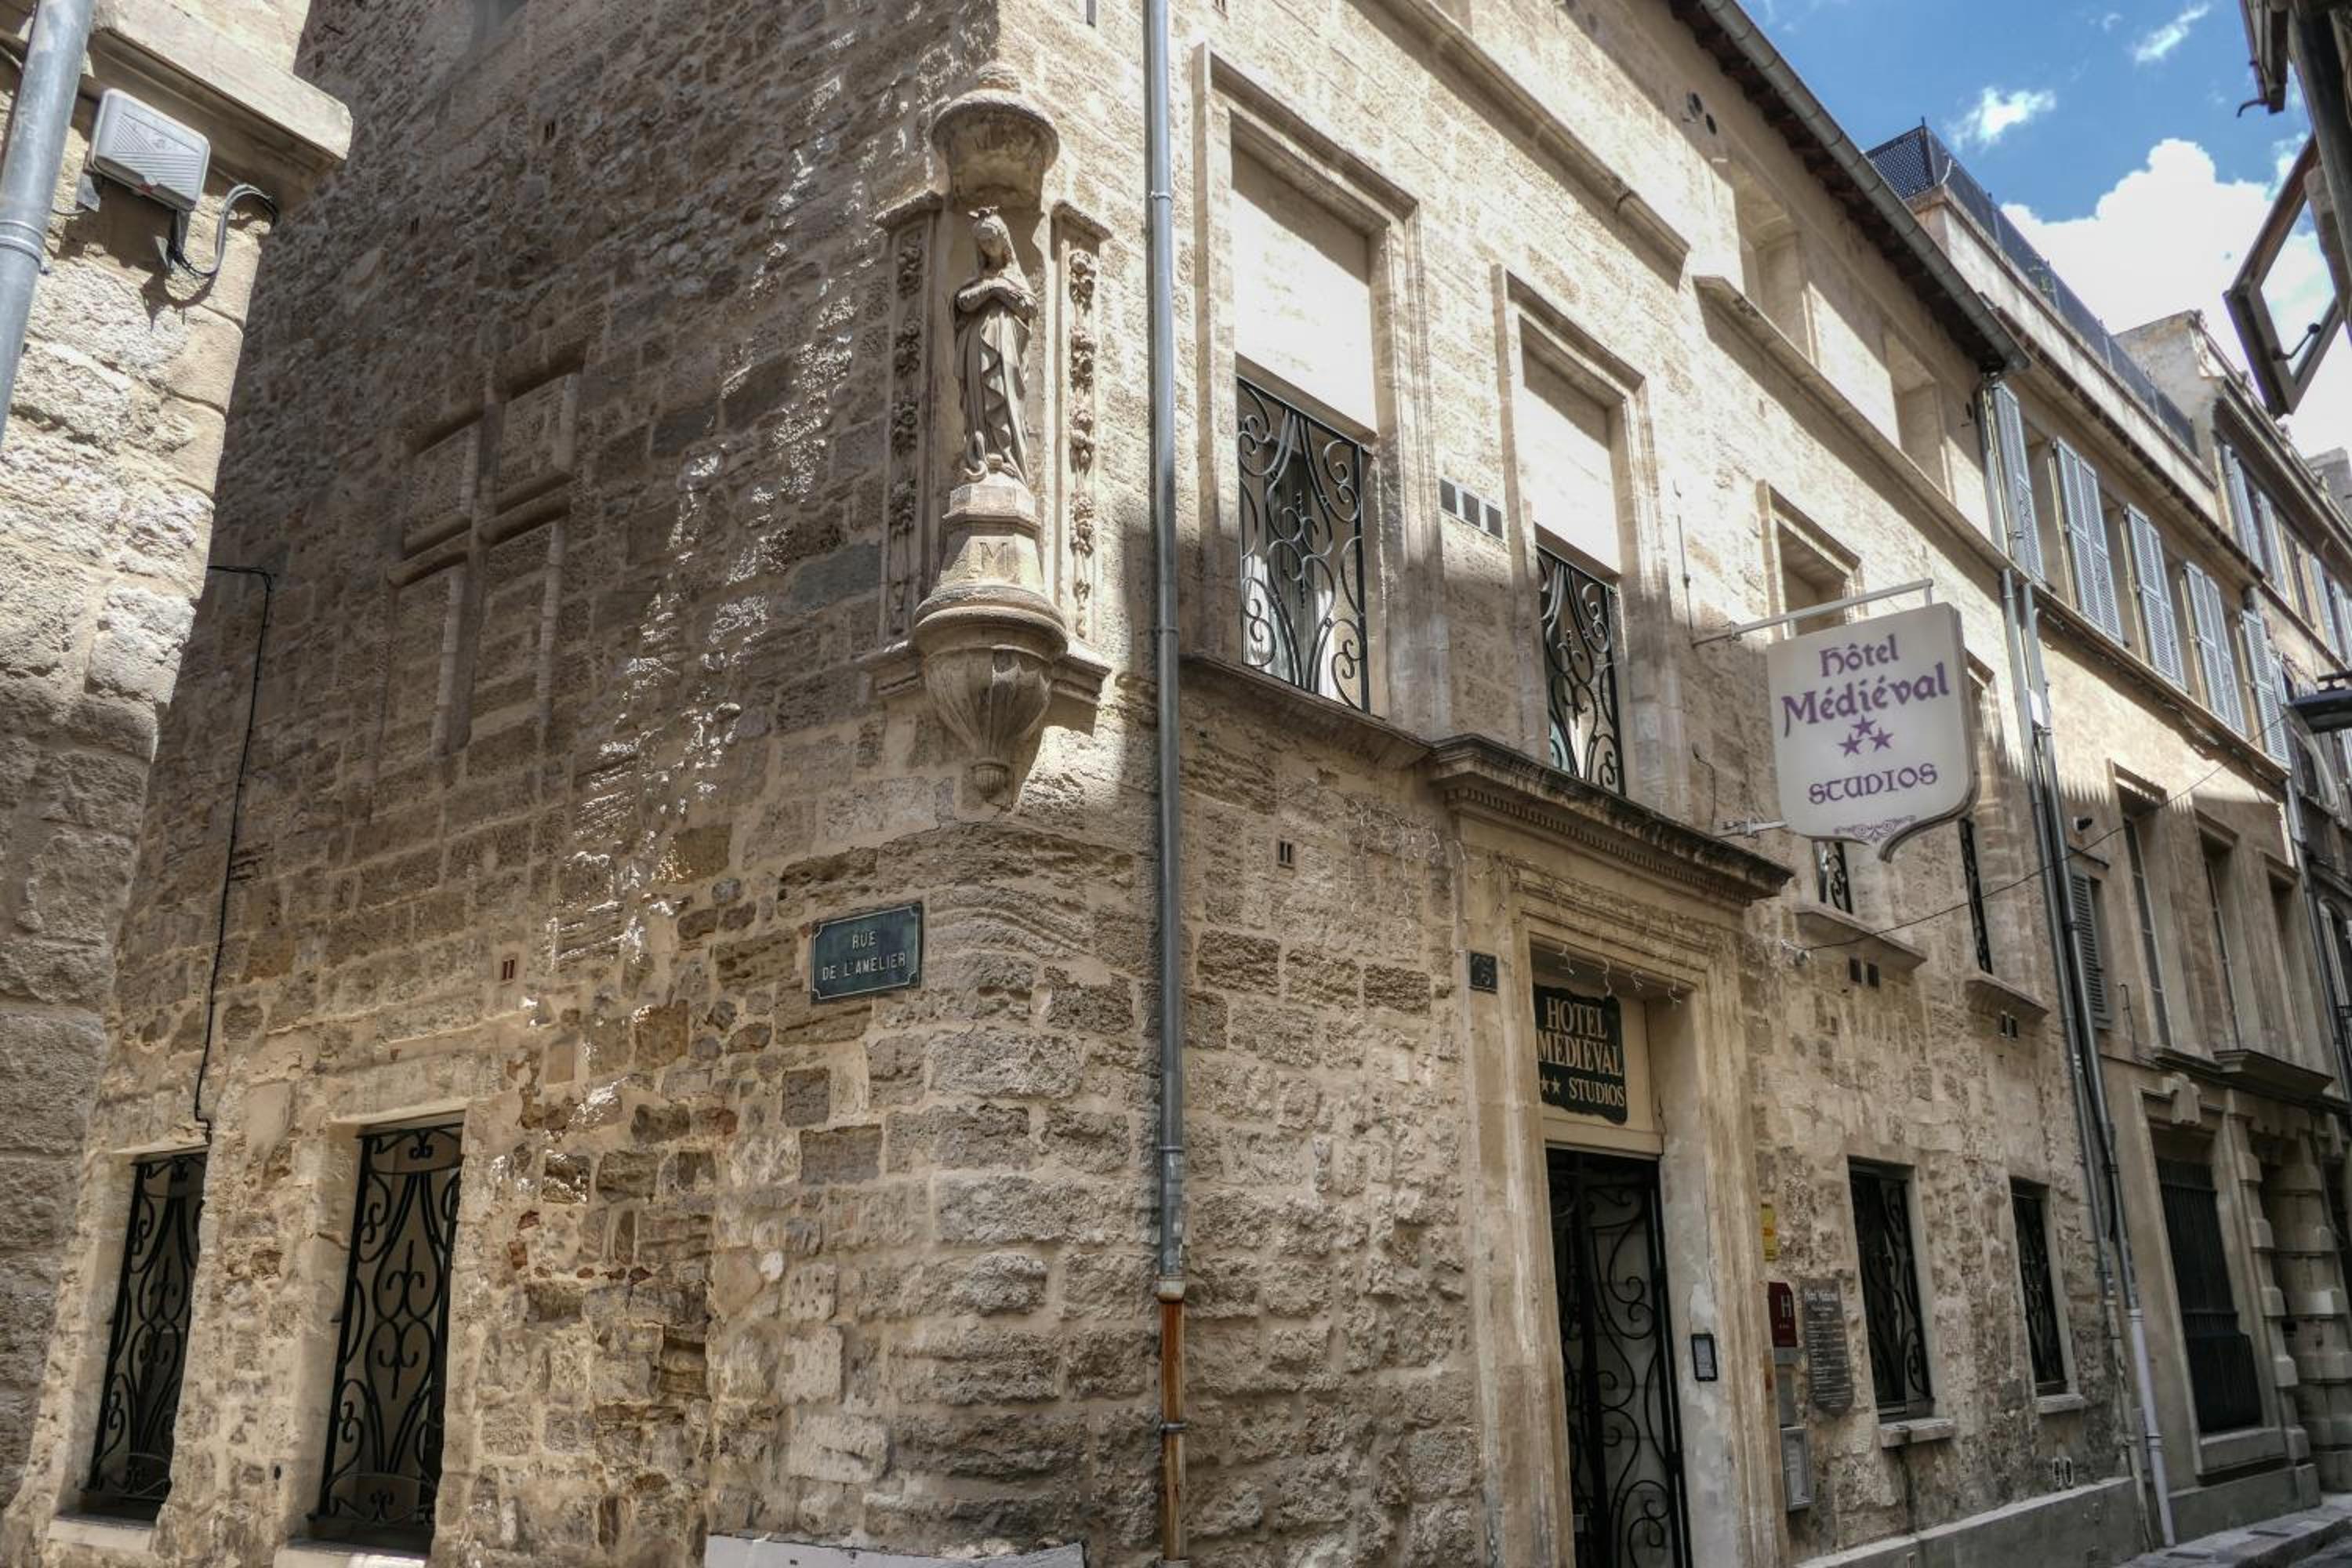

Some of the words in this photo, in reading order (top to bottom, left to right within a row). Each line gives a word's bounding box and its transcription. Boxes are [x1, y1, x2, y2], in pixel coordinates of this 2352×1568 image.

[1819, 633, 1899, 677] Hôtel
[1781, 662, 1949, 738] Médiéval
[1809, 763, 1938, 804] STUDIOS
[852, 931, 877, 949] RUE
[822, 965, 837, 981] DE
[1545, 996, 1607, 1040] HOTEL
[1569, 1076, 1625, 1107] STUDIOS
